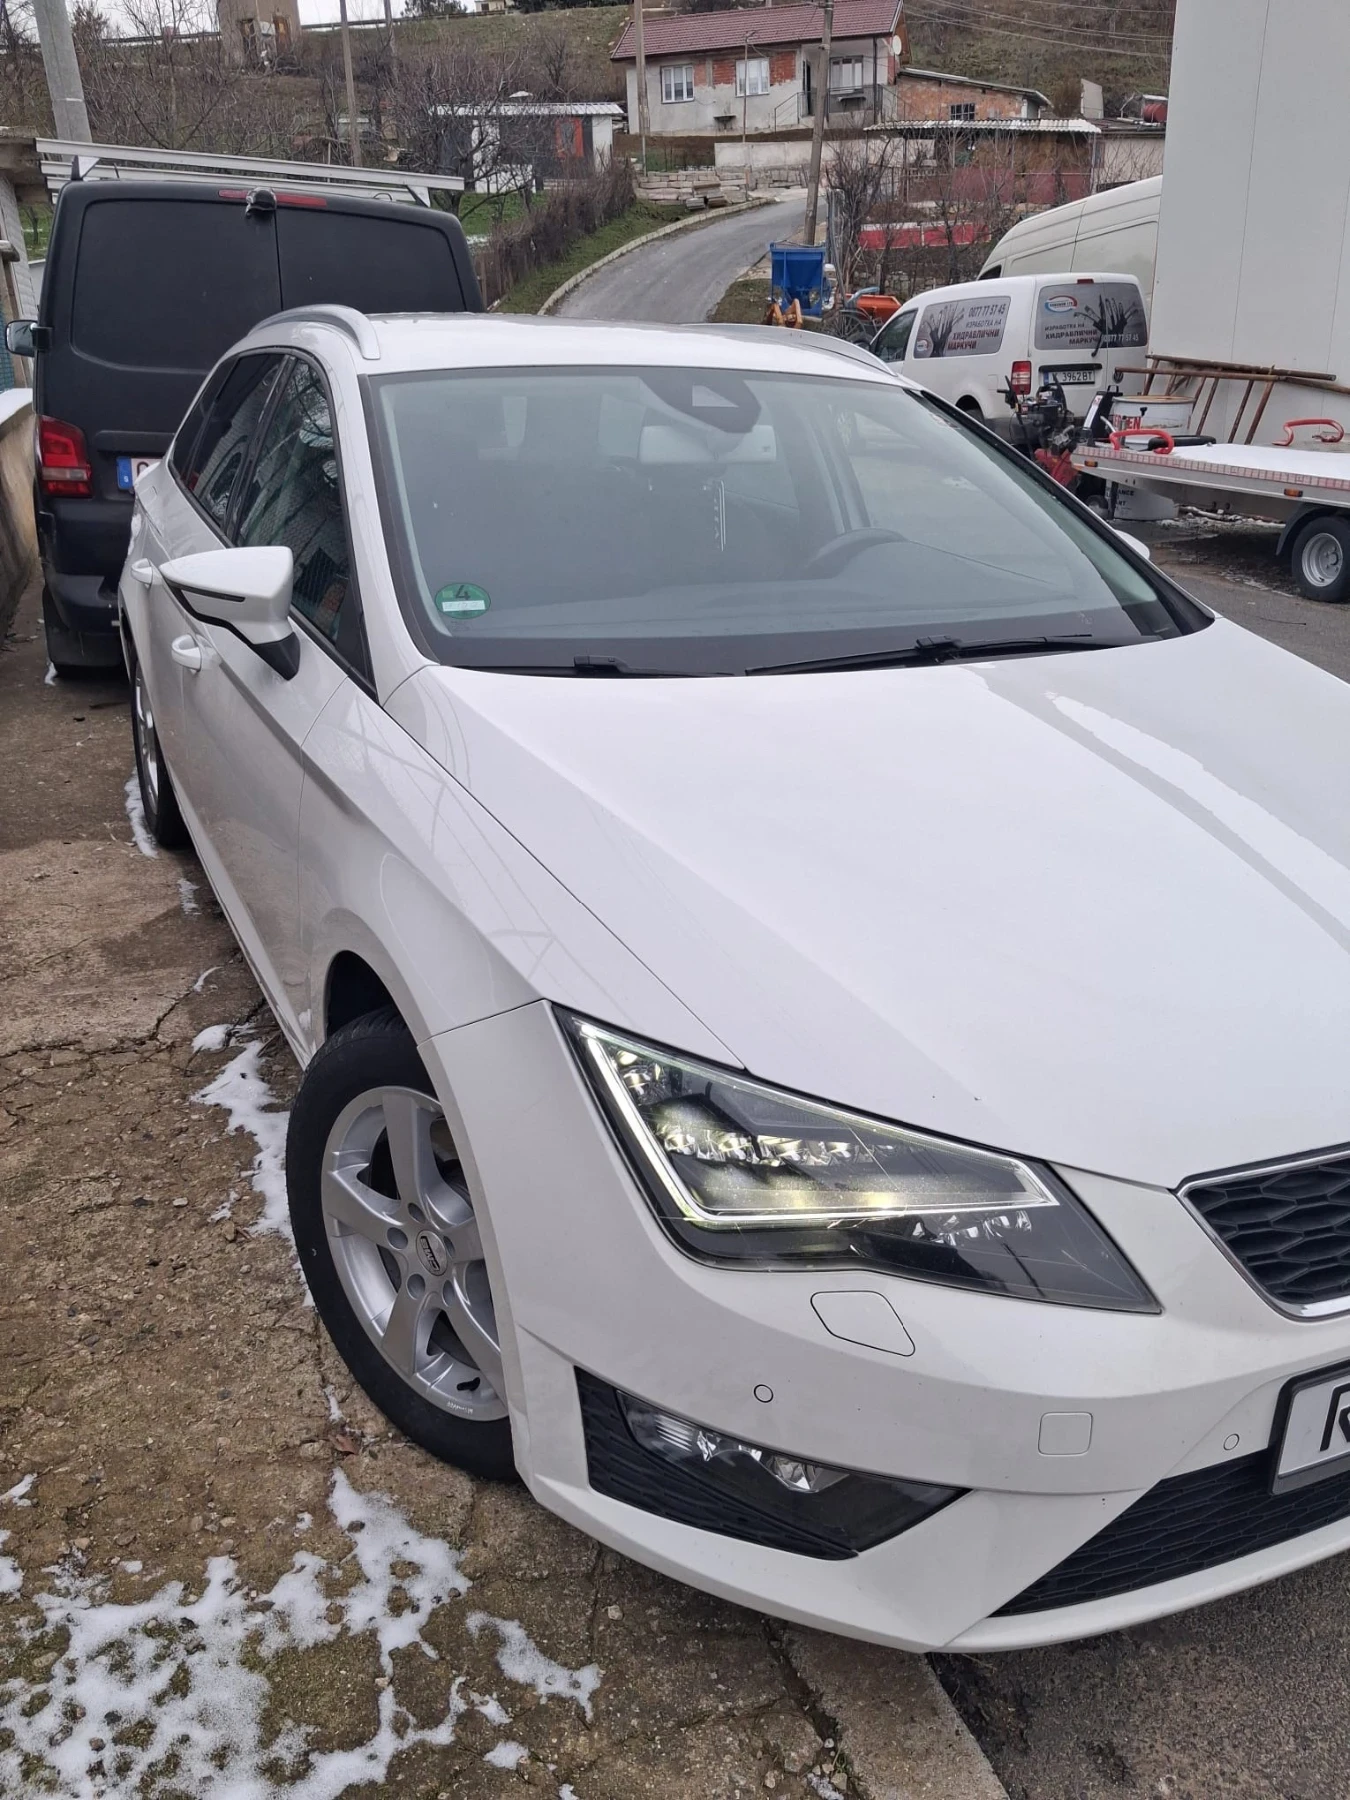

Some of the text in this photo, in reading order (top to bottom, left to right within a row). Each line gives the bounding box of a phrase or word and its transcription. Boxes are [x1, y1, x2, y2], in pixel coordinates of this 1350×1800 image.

[983, 305, 991, 316] 77
[998, 303, 1006, 315] 45
[455, 584, 471, 601] 4
